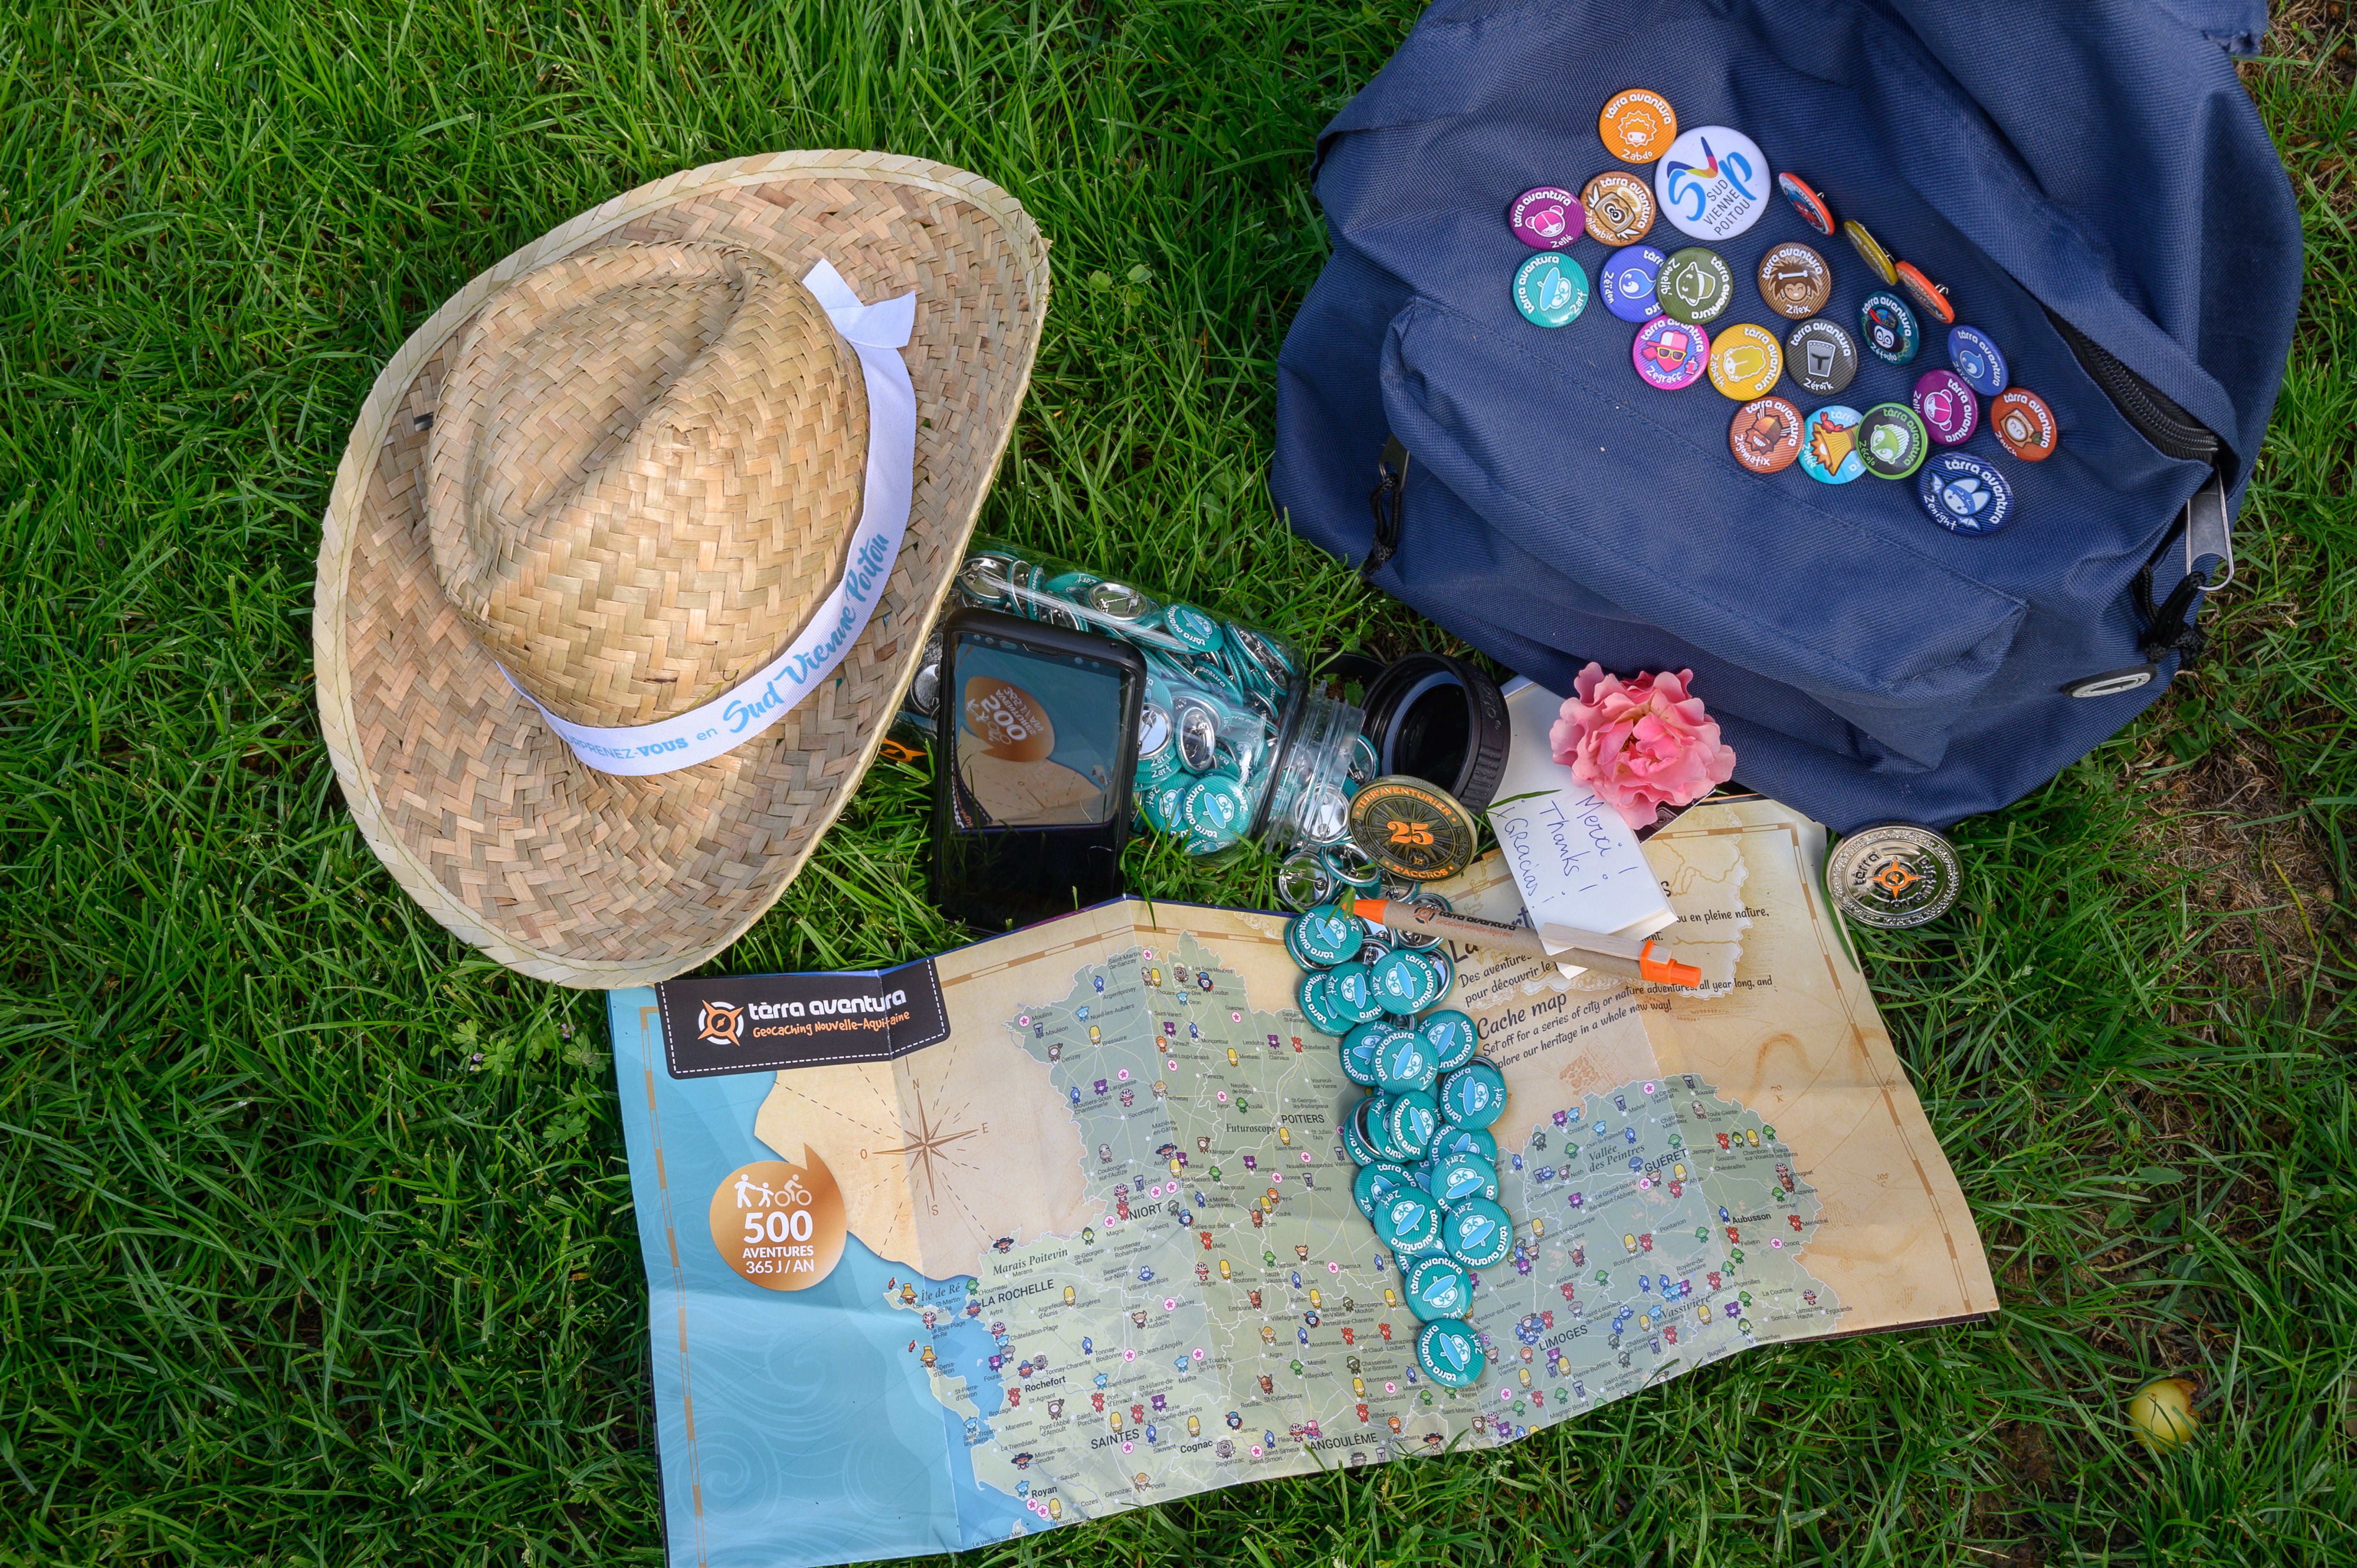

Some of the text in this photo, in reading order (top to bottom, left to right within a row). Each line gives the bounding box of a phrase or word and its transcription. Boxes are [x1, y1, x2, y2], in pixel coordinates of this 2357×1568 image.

[1707, 179, 1728, 202] SUD
[1703, 188, 1740, 225] VIENNE
[1714, 201, 1751, 236] POITOU
[696, 728, 718, 741] en
[723, 681, 784, 733] Sud
[774, 606, 856, 684] Vienne
[846, 533, 889, 601] Poitou
[1356, 787, 1452, 816] TERR'AVENTURIER
[1387, 821, 1434, 845] 25
[1392, 865, 1448, 878] Z'ACCROS
[1458, 971, 1481, 988] Des
[1704, 910, 1733, 924] pleine
[1735, 906, 1769, 919] nature,
[1103, 987, 1136, 1000] Argentonnay
[1465, 962, 1551, 1008] pour découvrir le
[808, 989, 907, 1016] aventura
[753, 1011, 910, 1039] Geocaching Nouvelle-Aquitaine
[1032, 1011, 1052, 1021] Moulins
[1477, 993, 1567, 1040] Cache map
[1482, 1040, 1501, 1057] Set
[1501, 1033, 1515, 1048] off
[1517, 1030, 1530, 1043] for
[1542, 1014, 1569, 1032] series
[1571, 1006, 1581, 1020] of
[1583, 1001, 1600, 1015] city
[1603, 997, 1612, 1006] or
[1615, 985, 1644, 1001] nature
[1699, 980, 1710, 989] all
[1712, 981, 1732, 992] year
[1734, 978, 1755, 990] long,
[1757, 975, 1772, 986] and
[1046, 1026, 1069, 1036] Mauléon
[1523, 1045, 1538, 1058] our
[1541, 1030, 1578, 1052] heritage
[1580, 1024, 1589, 1035] in
[1600, 1008, 1627, 1026] whole
[1630, 1003, 1648, 1014] new
[1650, 999, 1672, 1014] way!
[1102, 1035, 1127, 1046] Bressuire
[1061, 1053, 1081, 1063] Cerizay
[1128, 1106, 1159, 1119] Secondigny
[1281, 1114, 1324, 1123] POITIERS
[1226, 1123, 1276, 1132] Futuroscope
[1568, 1123, 1589, 1135] Crozant
[1589, 1145, 1617, 1161] Vallée
[1589, 1144, 1645, 1173] des Peintres
[1645, 1148, 1687, 1173] GUÉRET
[1129, 1203, 1162, 1221] NIORT
[1732, 1213, 1771, 1224] Aubusson
[743, 1210, 813, 1244] 500
[742, 1245, 814, 1259] AVENTURES
[746, 1262, 774, 1274] 365
[992, 1248, 1069, 1275] Marais Poitevin
[935, 1287, 945, 1298] de
[949, 1283, 961, 1295] Ré
[981, 1279, 1054, 1307] LA ROCHELLE
[1076, 1298, 1101, 1309] Surgères
[1662, 1294, 1711, 1319] Vassivière
[1539, 1325, 1588, 1351] LIMOGES
[1024, 1376, 1066, 1392] Rochefort
[989, 1407, 1011, 1417] Brouage
[1006, 1421, 1033, 1430] Marennes
[1091, 1429, 1140, 1449] SAINTES
[1180, 1441, 1213, 1454] Cognac
[1310, 1433, 1378, 1452] ANGOULÊME
[1216, 1458, 1244, 1467] Segonzac
[1031, 1486, 1057, 1498] Royan
